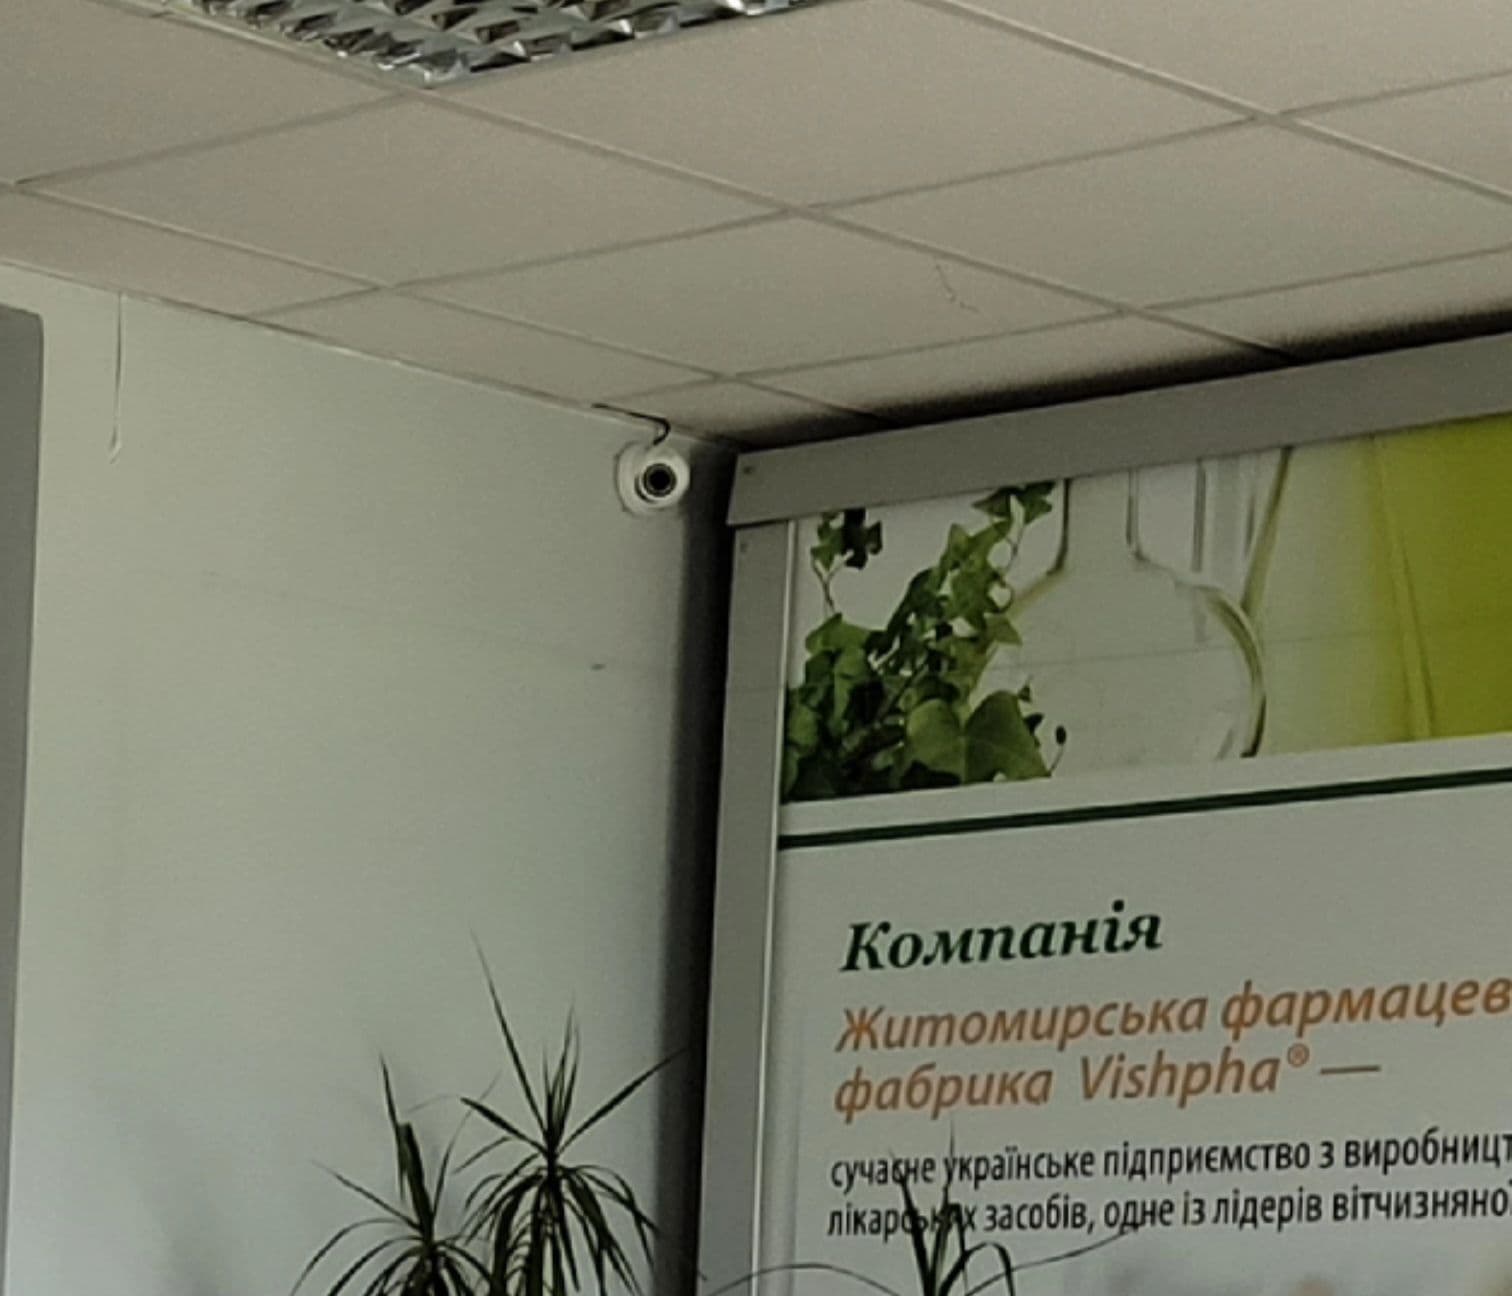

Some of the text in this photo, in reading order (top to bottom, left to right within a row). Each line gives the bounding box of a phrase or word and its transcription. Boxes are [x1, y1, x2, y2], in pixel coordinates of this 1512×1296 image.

[839, 899, 1163, 972] Компанія
[834, 976, 1512, 1053] Житомирська фармацев
[834, 1061, 1054, 1125] фабрика
[830, 1156, 937, 1195] сучасне
[942, 1145, 1096, 1191] українське
[1103, 1140, 1311, 1184] підприємство
[1318, 1140, 1335, 1169] з
[827, 1201, 977, 1244] лікарськх
[983, 1192, 1096, 1234] засобів,
[1103, 1198, 1175, 1232] одне
[1182, 1189, 1206, 1226] із
[1211, 1185, 1323, 1232] лідерів
